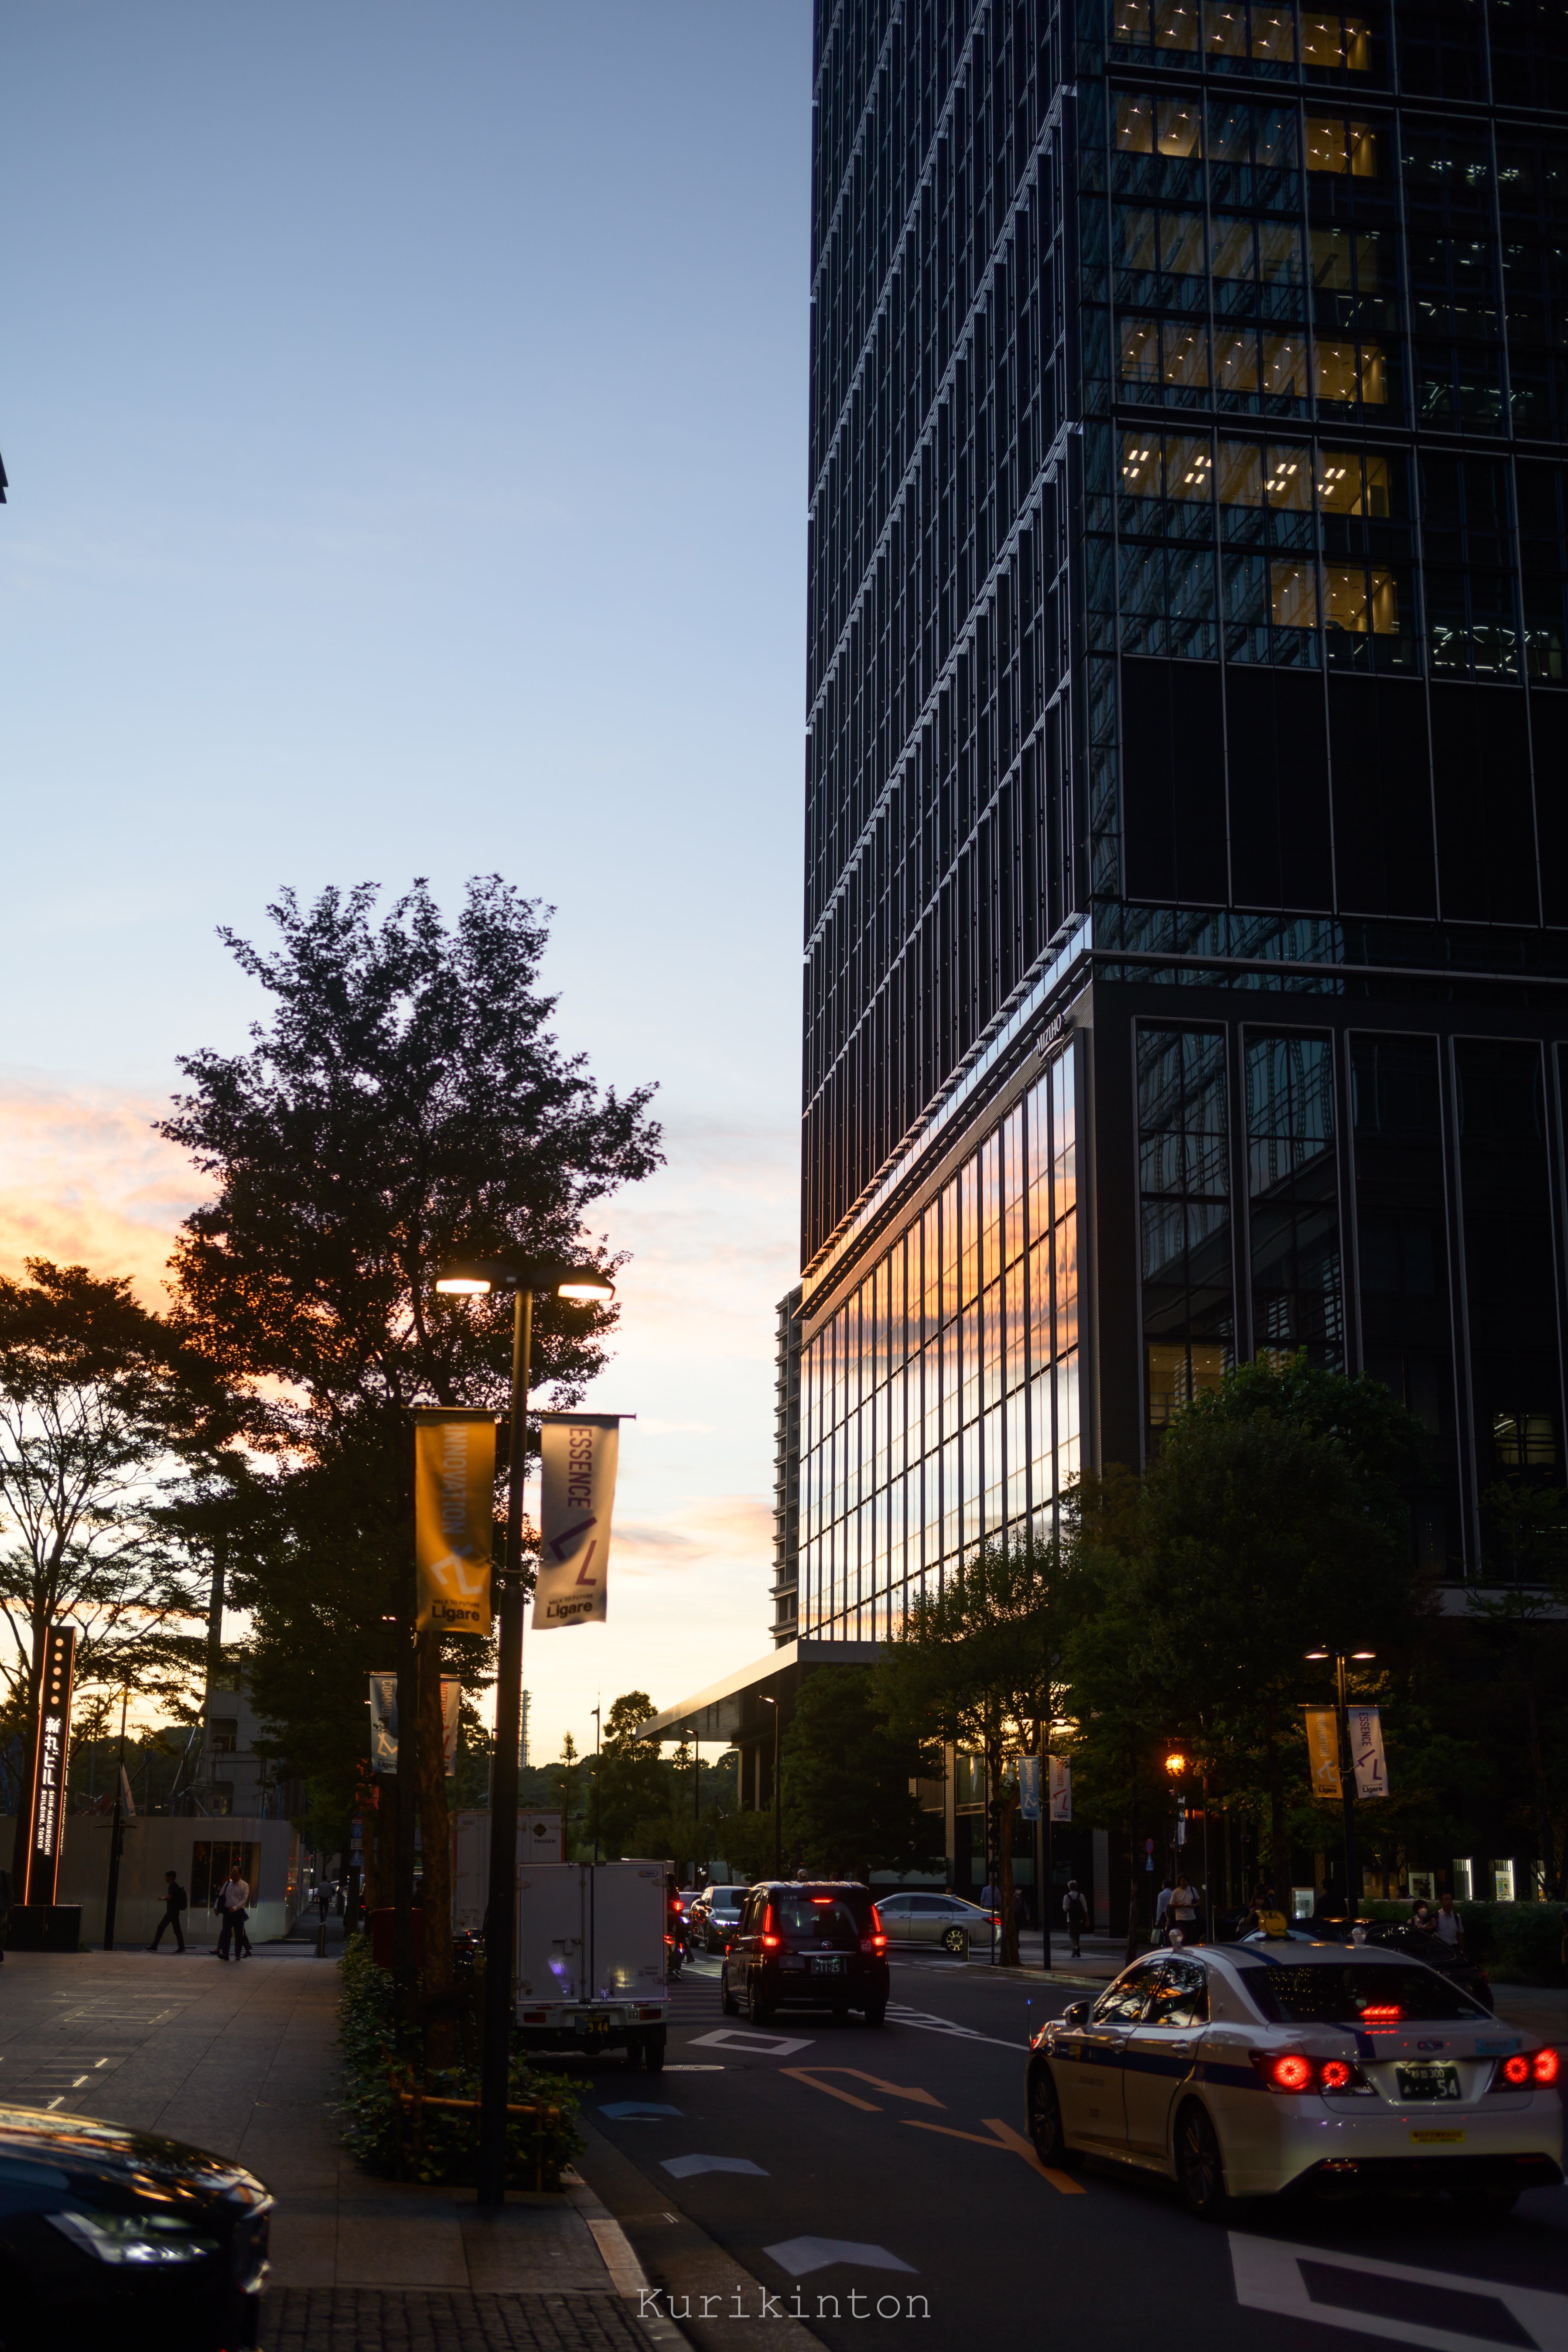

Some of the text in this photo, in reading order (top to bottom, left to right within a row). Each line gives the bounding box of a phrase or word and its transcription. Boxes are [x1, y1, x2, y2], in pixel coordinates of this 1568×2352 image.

[1036, 1013, 1061, 1056] MIZUHO
[442, 1426, 468, 1534] INNOVATION
[568, 1428, 592, 1508] ESSENCE
[432, 1605, 479, 1622] Ligare
[547, 1602, 593, 1618] Ligare
[1315, 1712, 1329, 1757] INNOVATION
[1359, 1713, 1372, 1747] ESSENCE
[43, 1717, 61, 1785] 新丸ビル
[1025, 1759, 1033, 1793] COMMUNITY
[44, 1791, 55, 1855] SHIN-MARUNOUCHI
[354, 1827, 360, 1836] P
[820, 1964, 840, 1973] 11-25
[1429, 2068, 1445, 2079] 300
[1436, 2078, 1458, 2097] 54
